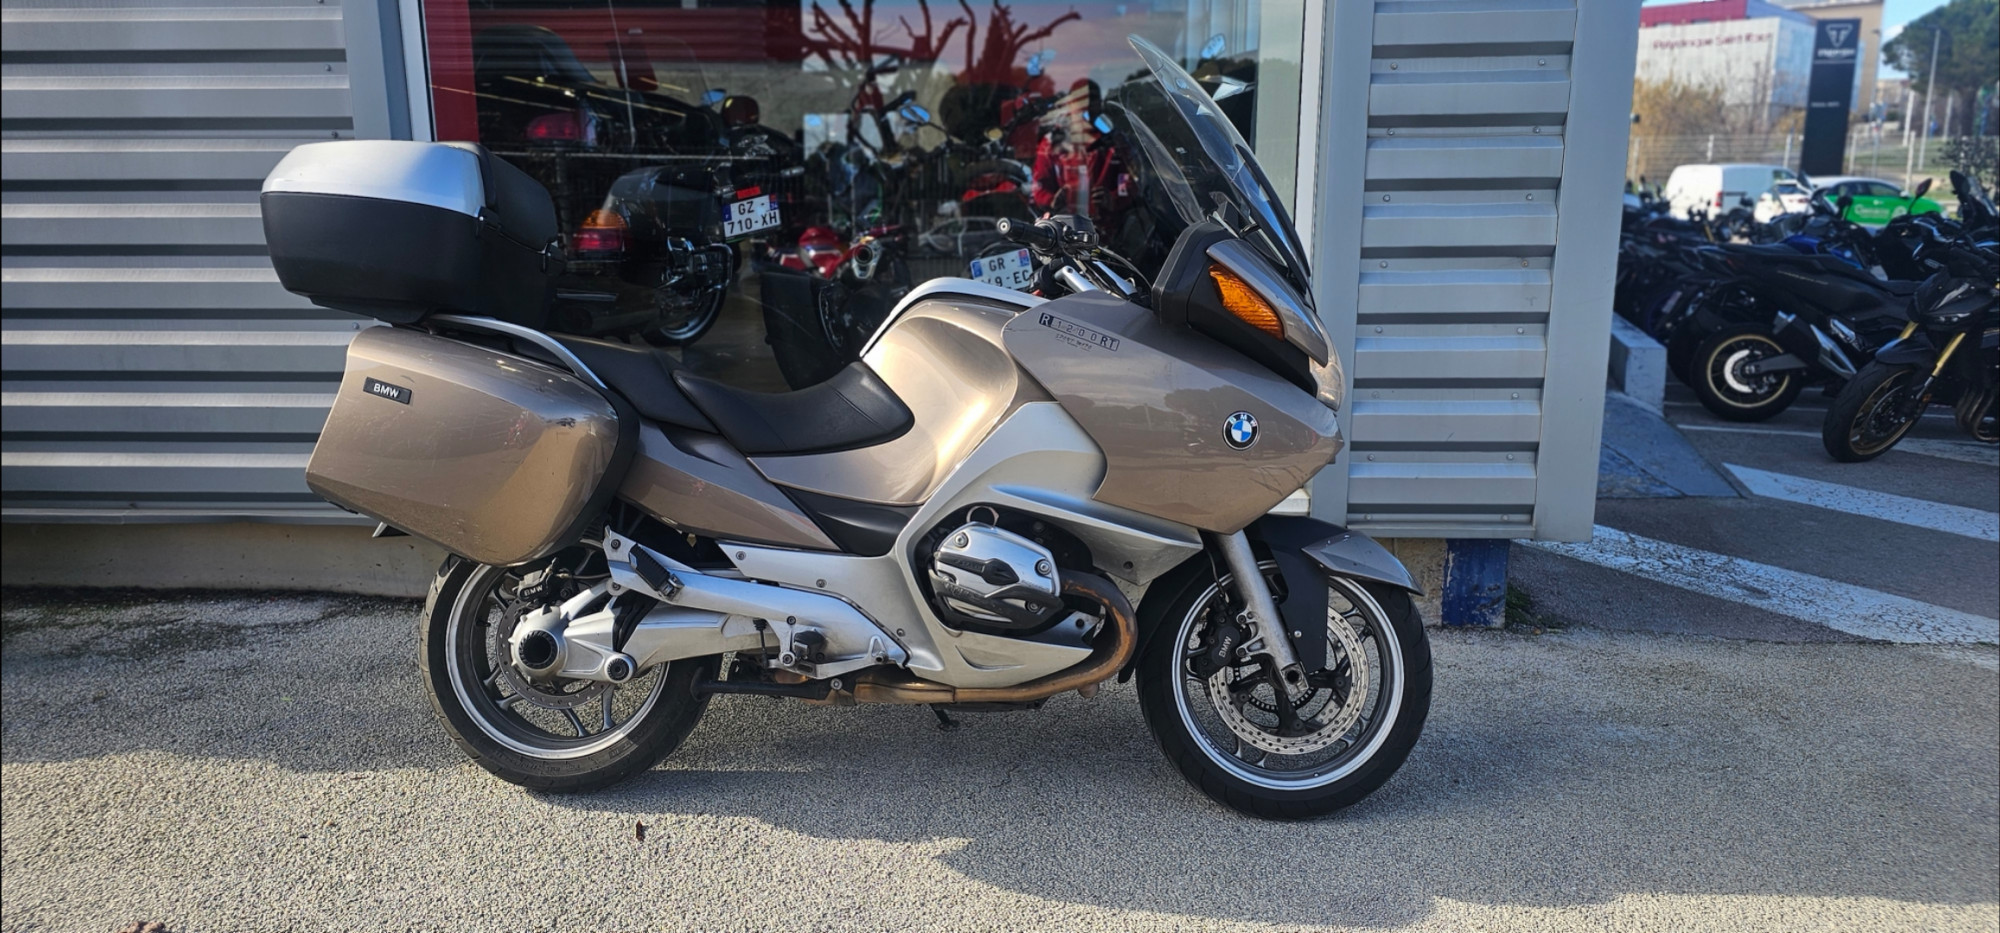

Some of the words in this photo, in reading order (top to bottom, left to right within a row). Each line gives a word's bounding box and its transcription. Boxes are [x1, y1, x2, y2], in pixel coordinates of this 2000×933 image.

[738, 200, 755, 215] GZ
[727, 211, 778, 235] 710-XH
[988, 257, 1006, 272] GR
[373, 382, 400, 399] BMW
[523, 585, 543, 597] BMW
[1218, 635, 1232, 658] BMW
